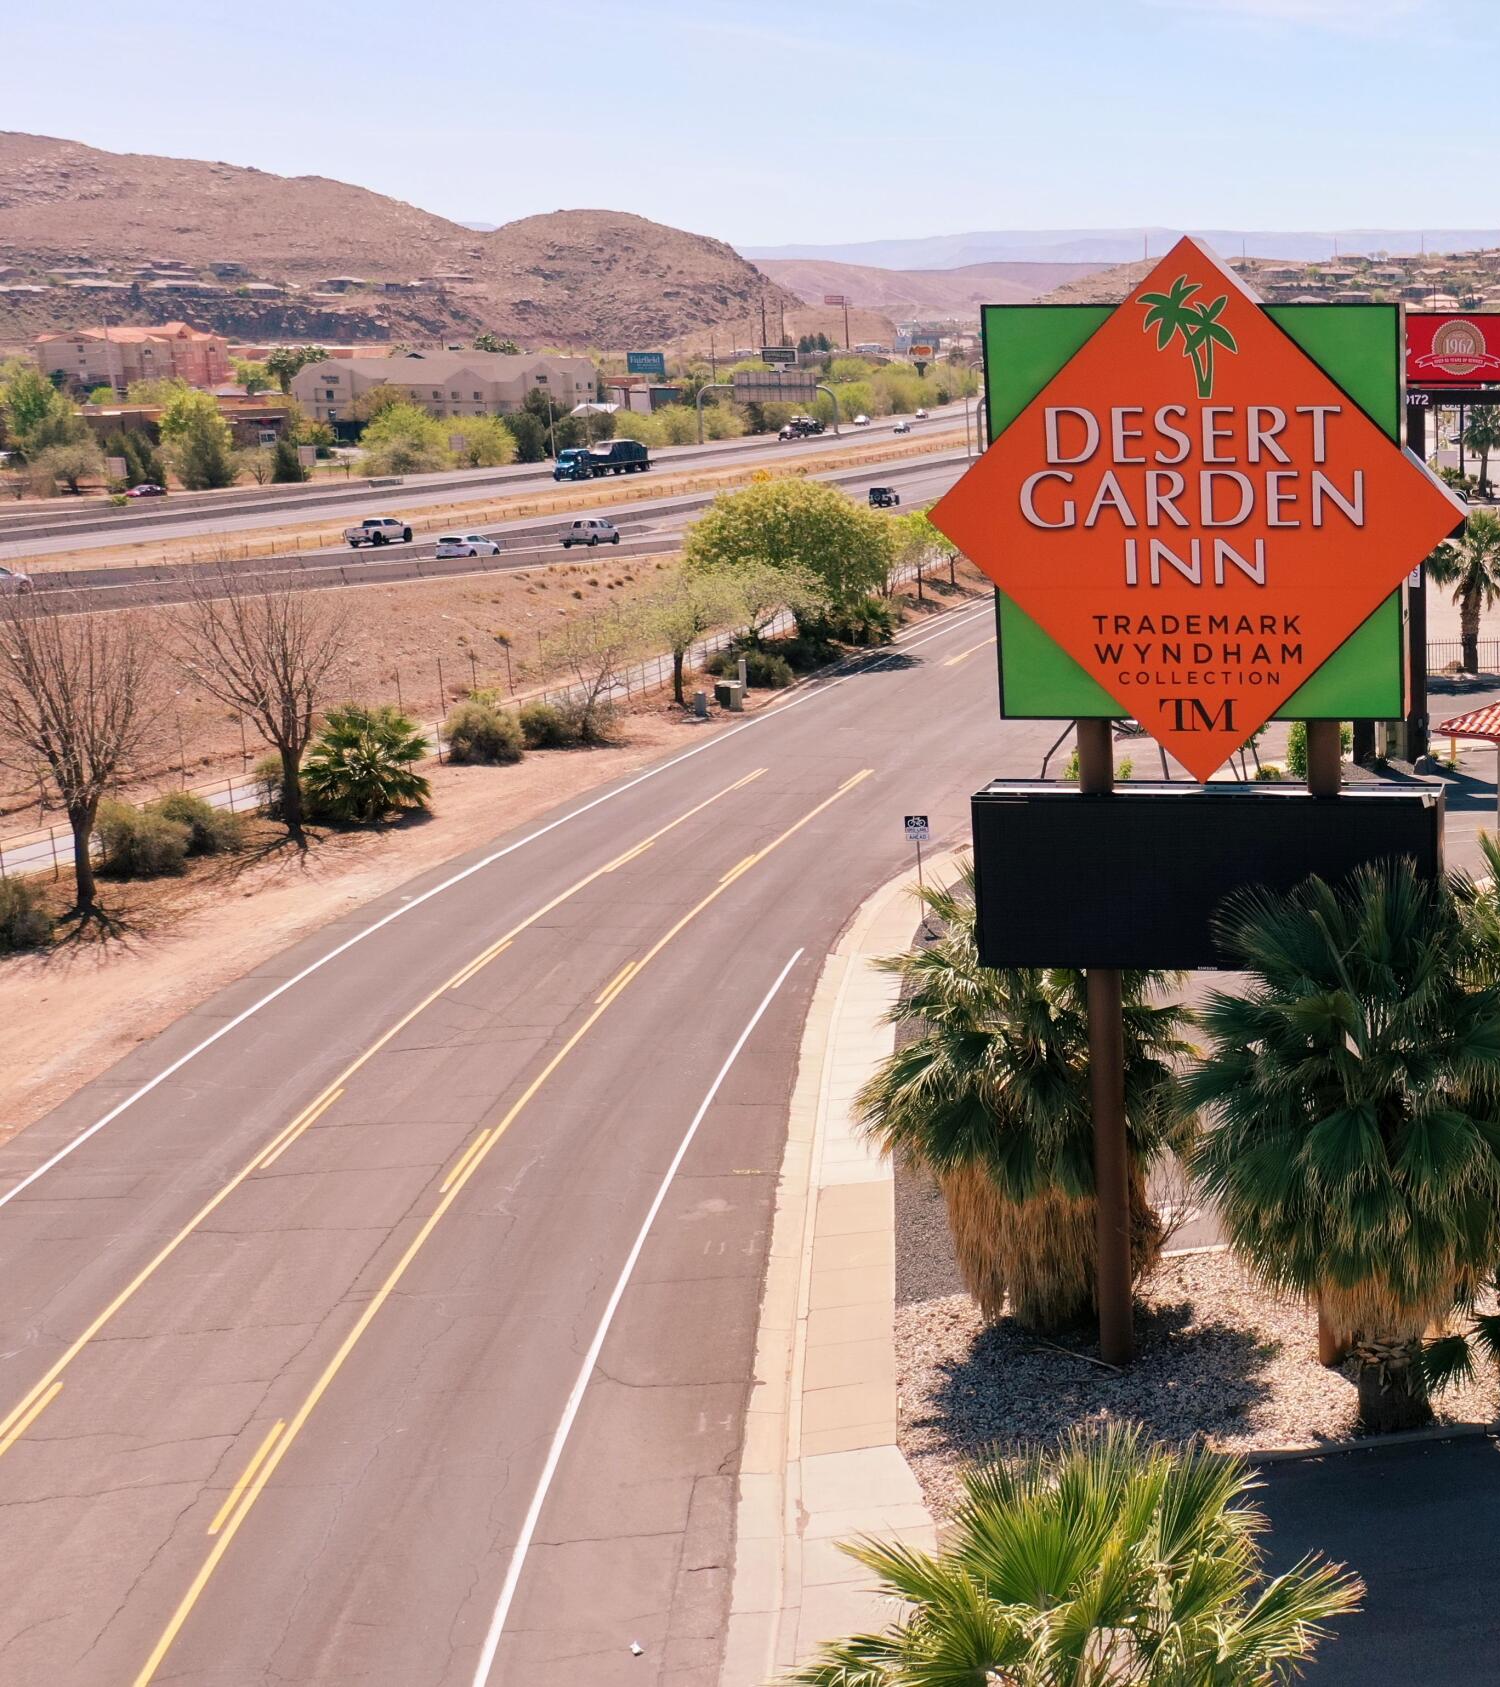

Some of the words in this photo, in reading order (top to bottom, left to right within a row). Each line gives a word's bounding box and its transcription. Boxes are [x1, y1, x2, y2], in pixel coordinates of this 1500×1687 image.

[1445, 339, 1474, 354] 1962
[1045, 405, 1341, 464] DESERT
[1019, 470, 1364, 528] GARDEN
[1125, 538, 1265, 585] INN
[1092, 615, 1301, 635] TRADEMARK
[1094, 643, 1303, 664] WYNDHAM
[1118, 671, 1280, 685] COLLECTION
[1159, 698, 1239, 732] TM
